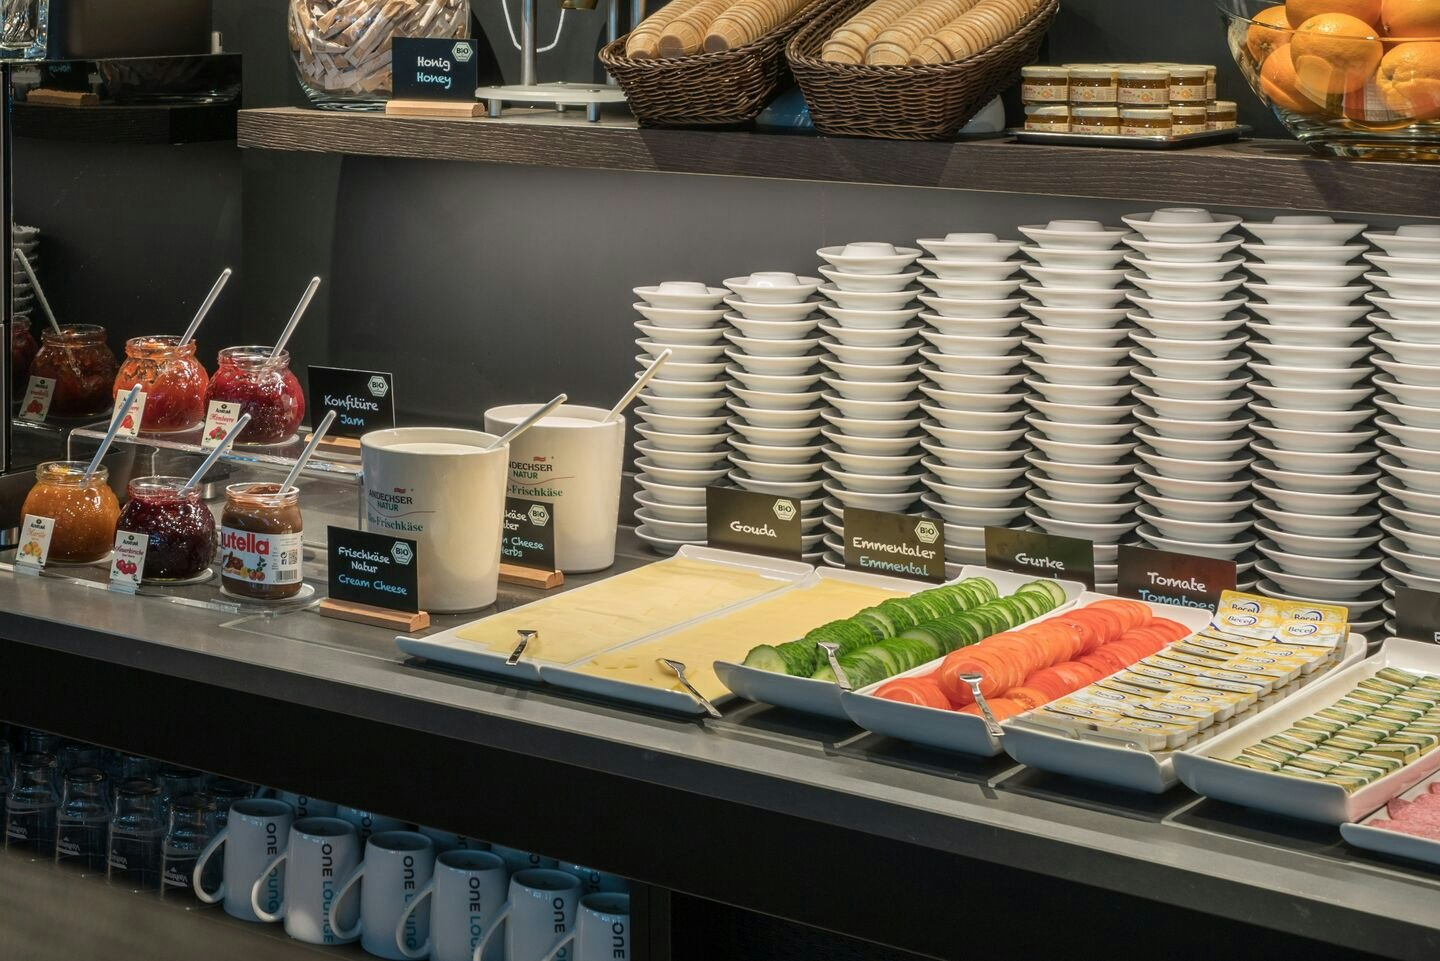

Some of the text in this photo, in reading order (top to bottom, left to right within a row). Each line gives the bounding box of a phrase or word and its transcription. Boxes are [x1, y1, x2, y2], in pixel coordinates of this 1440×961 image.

[417, 56, 451, 72] Honig
[416, 71, 451, 89] Honey
[371, 381, 385, 389] BIO
[324, 394, 379, 411] Konfitüre
[340, 414, 364, 426] Jam
[509, 461, 553, 472] NDECHSER
[513, 470, 538, 480] NATUR
[506, 484, 563, 497] -Frischkäse
[377, 500, 399, 512] NATUR
[532, 510, 545, 518] BIO
[777, 504, 792, 513] BIO
[729, 520, 777, 538] Gouda
[919, 526, 935, 535] BIO
[221, 531, 270, 555] utella
[396, 547, 409, 555] BIO
[511, 536, 545, 551] Cheese
[852, 537, 936, 560] Emmentaler
[338, 546, 390, 565] Frischkäse
[1014, 552, 1065, 570] Gurke
[351, 560, 378, 573] Natur
[859, 555, 930, 576] Emmental
[338, 573, 408, 595] Cream Cheese
[1146, 571, 1207, 593] Tomate
[1137, 589, 1216, 612] Tomatoes
[1227, 615, 1254, 626] Becel
[1287, 626, 1314, 635] Becel
[298, 795, 308, 817] ON
[266, 822, 280, 915] ONE OUNG
[322, 843, 333, 877] ONE
[403, 855, 415, 890] ONE
[468, 876, 480, 912] ONE
[553, 897, 566, 933] ONE
[612, 921, 625, 959] ONE
